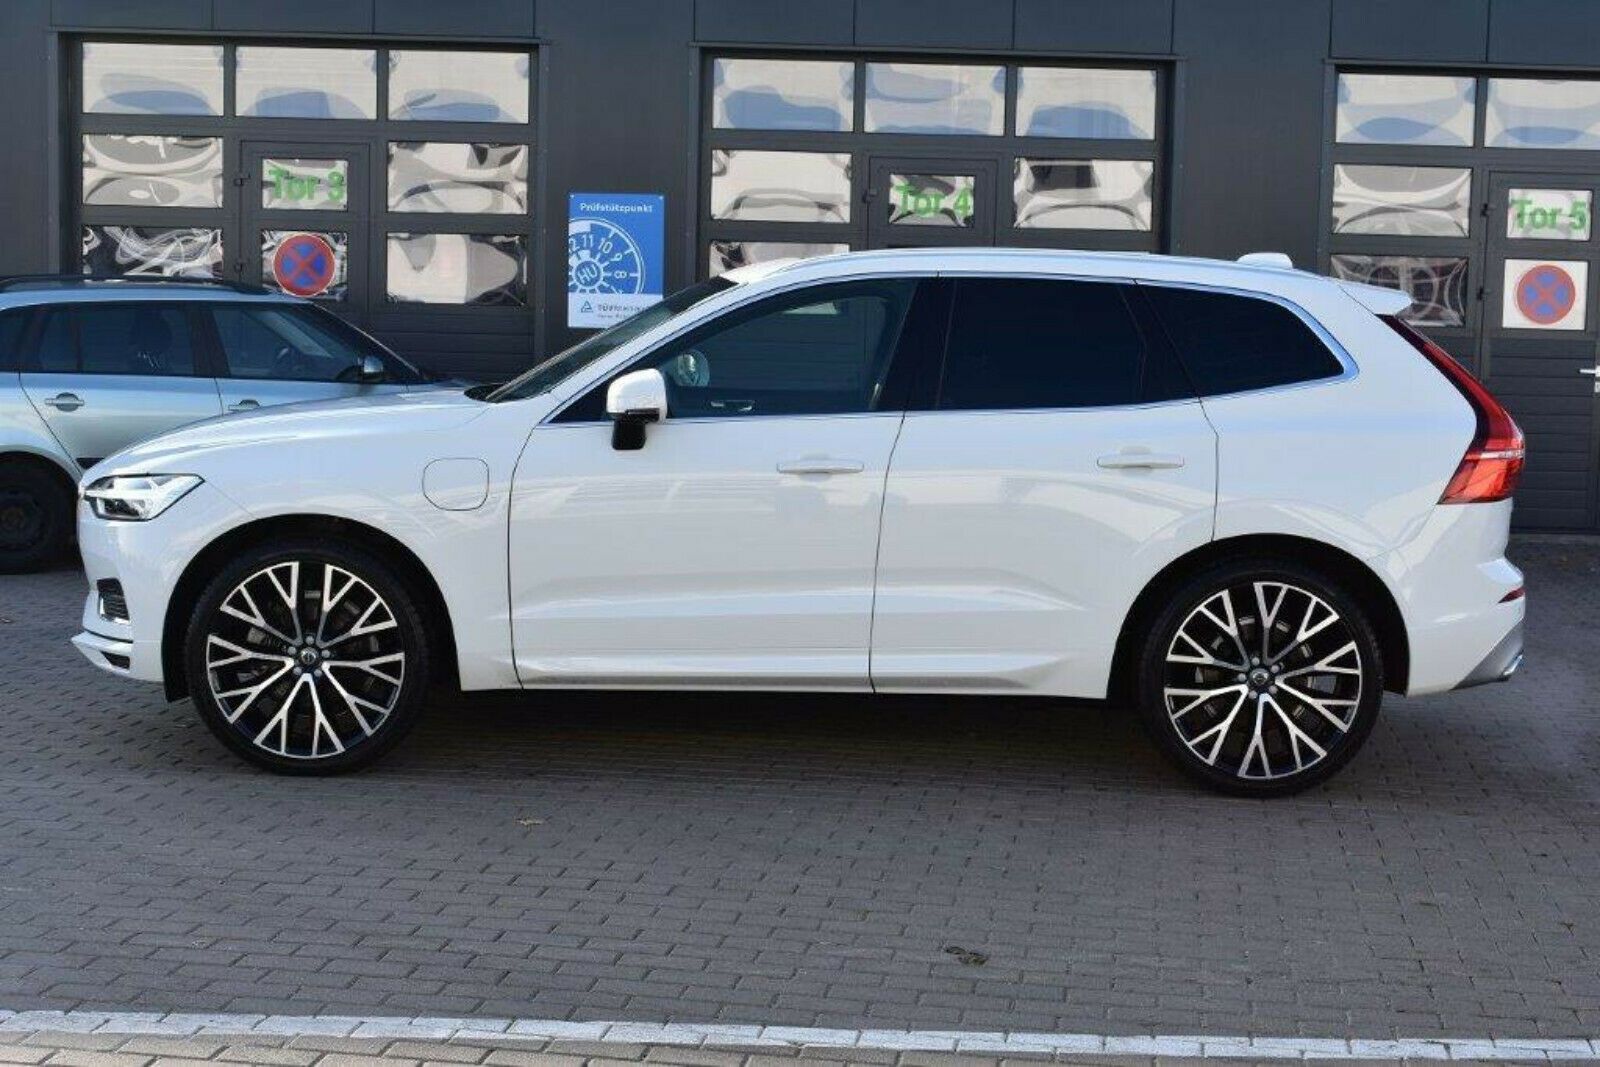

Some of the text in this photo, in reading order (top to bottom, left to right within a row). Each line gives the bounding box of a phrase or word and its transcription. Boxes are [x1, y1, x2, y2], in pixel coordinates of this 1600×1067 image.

[268, 168, 345, 200] Tor 3
[580, 202, 653, 214] Prüfstützpunkt
[895, 184, 972, 216] Tor 4
[1510, 199, 1587, 229] Tor 5
[582, 234, 594, 248] 11
[598, 237, 613, 254] 10
[610, 252, 623, 261] 9
[577, 263, 599, 285] HU
[613, 270, 628, 279] 8
